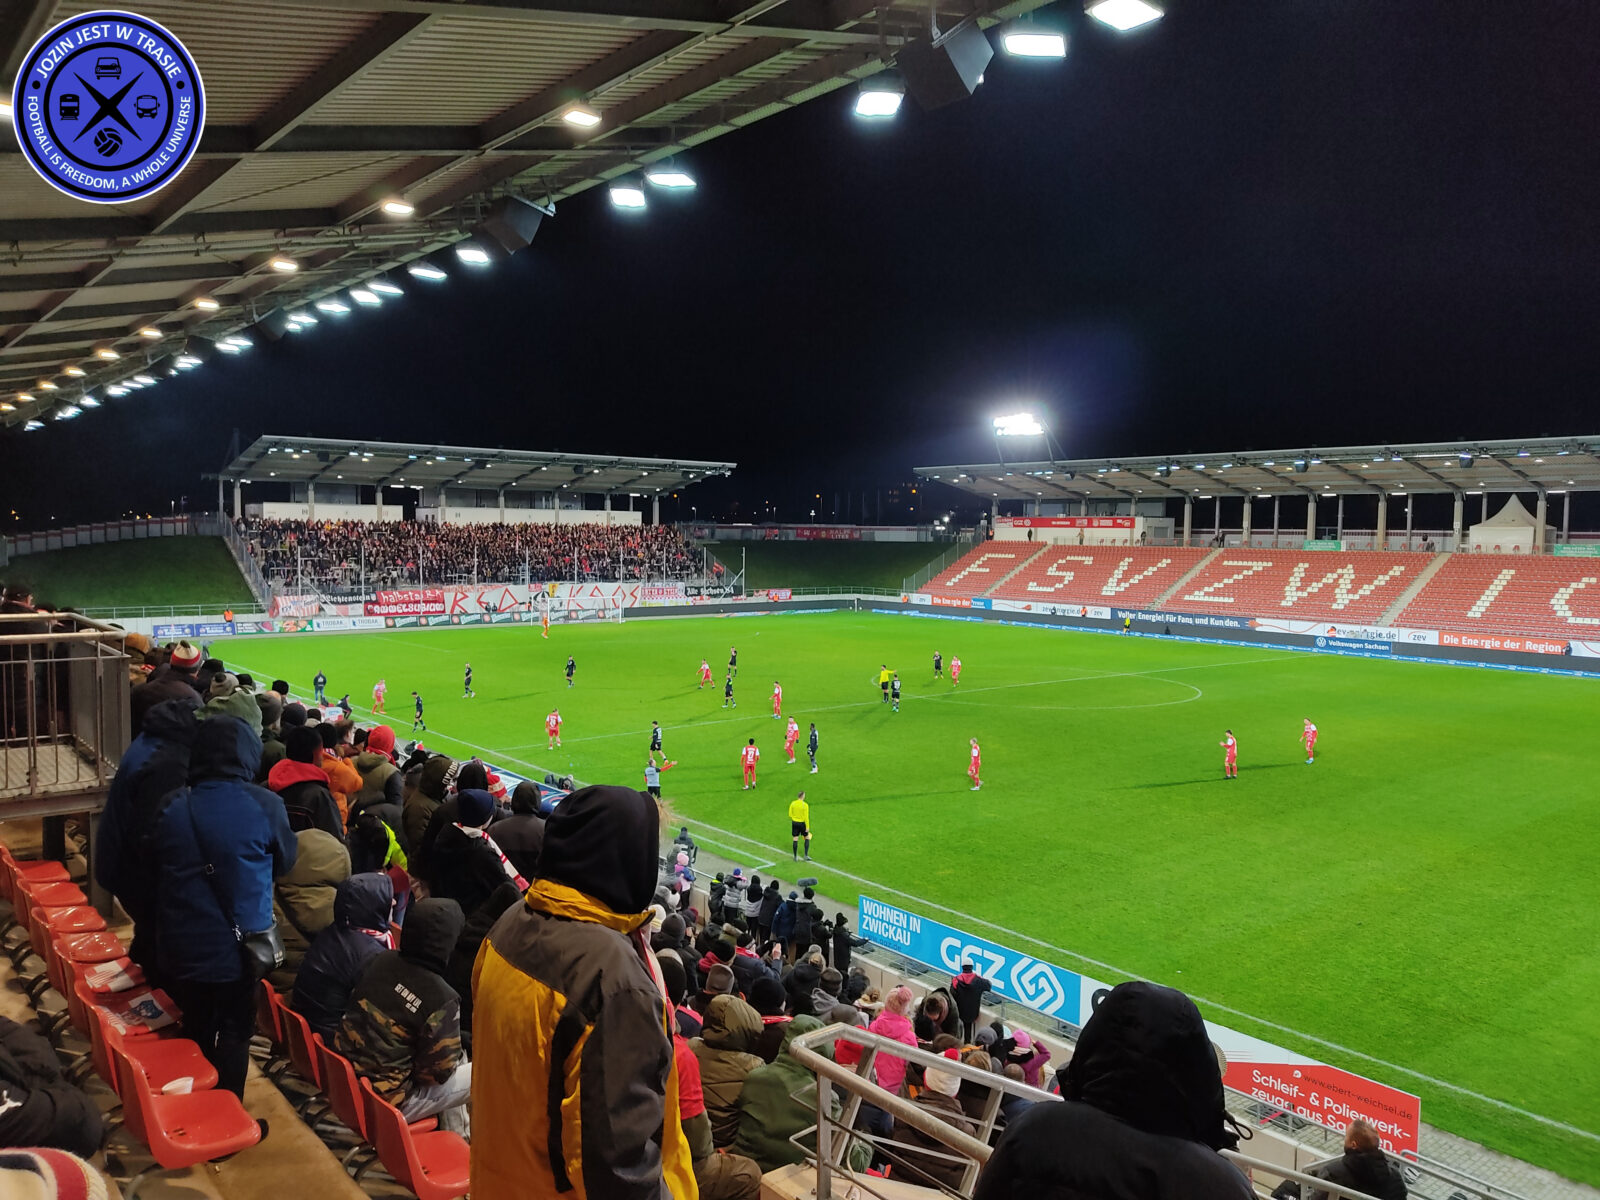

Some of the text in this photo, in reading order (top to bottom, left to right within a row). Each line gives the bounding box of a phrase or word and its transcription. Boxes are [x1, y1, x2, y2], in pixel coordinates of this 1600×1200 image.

[1117, 610, 1136, 620] Voller
[1166, 613, 1176, 623] Für
[1178, 616, 1193, 625] Fans
[1195, 617, 1208, 625] und
[1328, 640, 1390, 651] Volkswagen Sachsen
[1412, 634, 1426, 642] zev
[1443, 635, 1459, 645] Die
[1461, 637, 1500, 649] Energie
[1504, 639, 1520, 649] der
[862, 914, 911, 946] ZWICKAU
[863, 899, 921, 934] WOHNEN IN
[1252, 1069, 1411, 1139] Schleif- & Polierwerk-
[1303, 1075, 1413, 1120] www.ebert-weichsel.de
[1296, 1106, 1323, 1124] aus
[1327, 1114, 1397, 1154] Saen.
